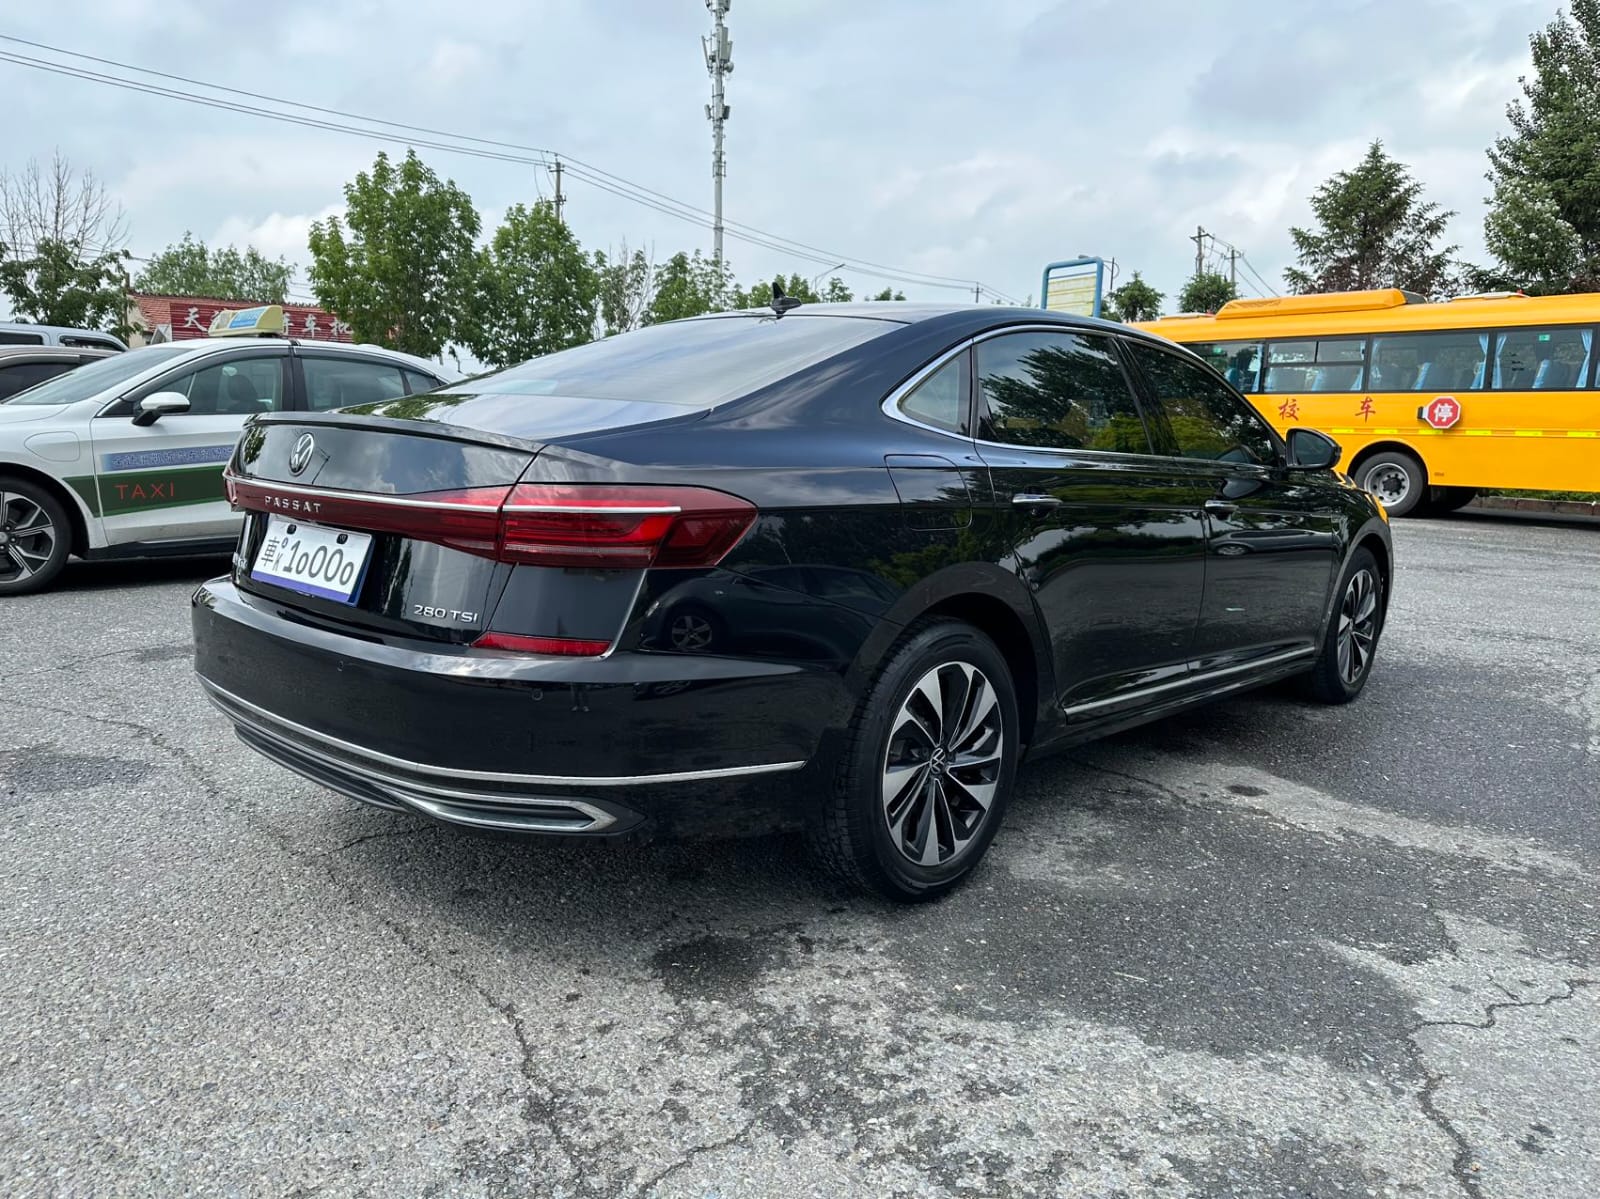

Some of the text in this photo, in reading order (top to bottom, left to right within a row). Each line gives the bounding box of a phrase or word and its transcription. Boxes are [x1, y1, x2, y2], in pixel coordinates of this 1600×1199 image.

[1433, 403, 1453, 423] 停
[114, 480, 175, 500] TAXI
[264, 495, 322, 514] PASSAT
[413, 604, 479, 624] 280 TSI
